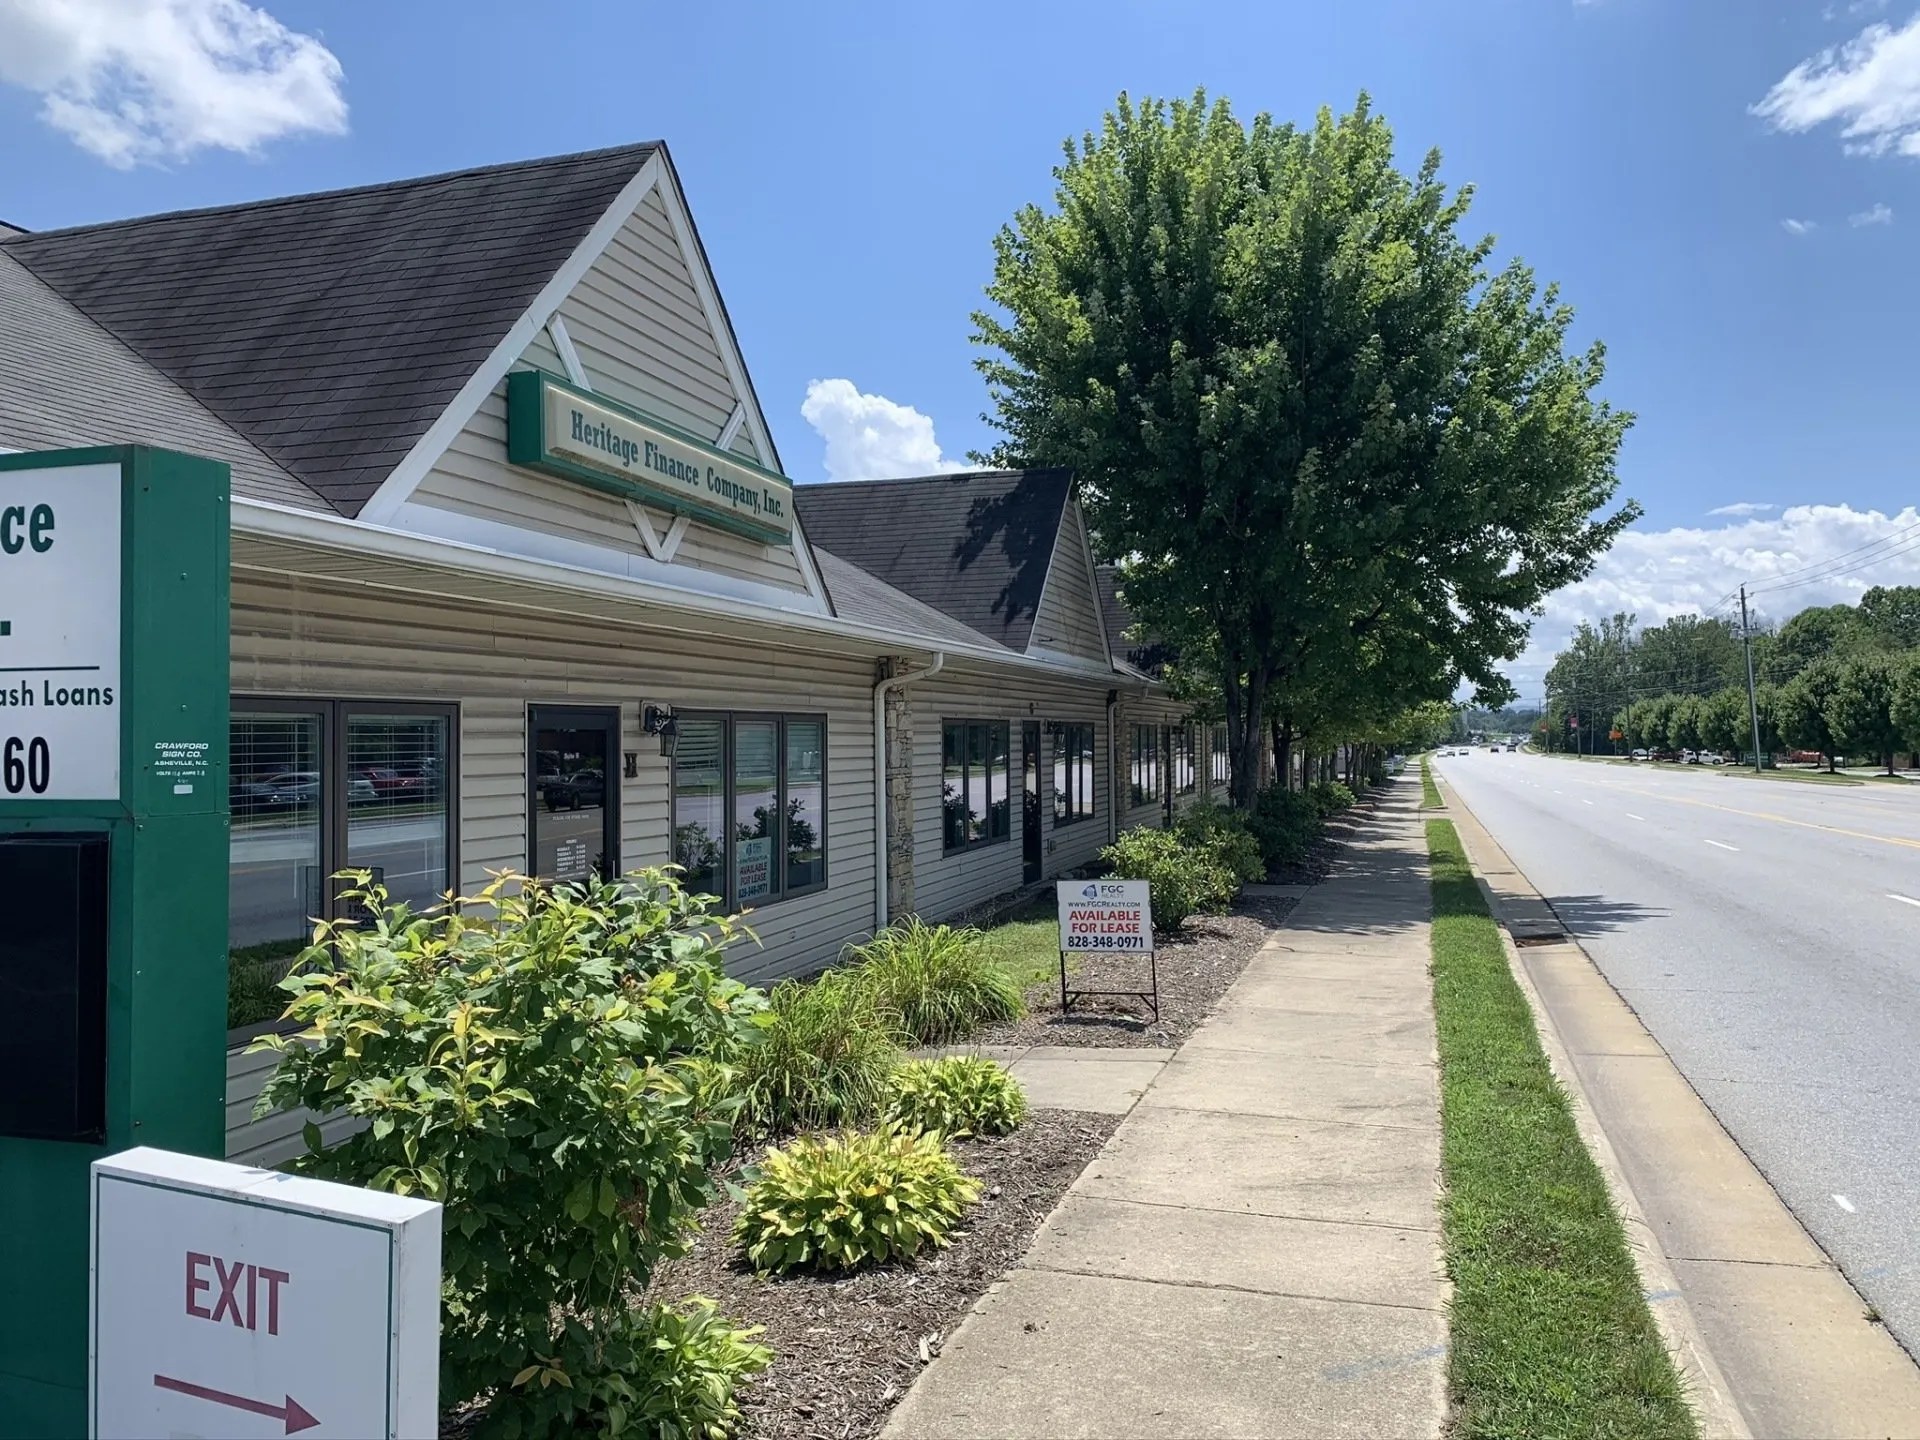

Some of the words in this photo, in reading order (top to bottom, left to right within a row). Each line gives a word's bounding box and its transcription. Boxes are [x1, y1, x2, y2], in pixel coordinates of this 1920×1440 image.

[571, 409, 639, 467] Heritage
[644, 440, 699, 486] Finance
[706, 466, 761, 514] Company,
[763, 489, 784, 518] Inc.
[44, 679, 114, 706] Loans
[155, 742, 209, 750] CRAWFORD
[161, 750, 185, 758] SIGN
[186, 750, 202, 758] CO.
[3, 736, 50, 794] 60
[1101, 885, 1124, 893] FGC
[1069, 910, 1141, 920] AVAILABLE
[1072, 923, 1097, 933] FOR
[1101, 923, 1140, 933] LEASE
[1068, 936, 1144, 948] 828-348-0971
[186, 1250, 290, 1336] EXIT
